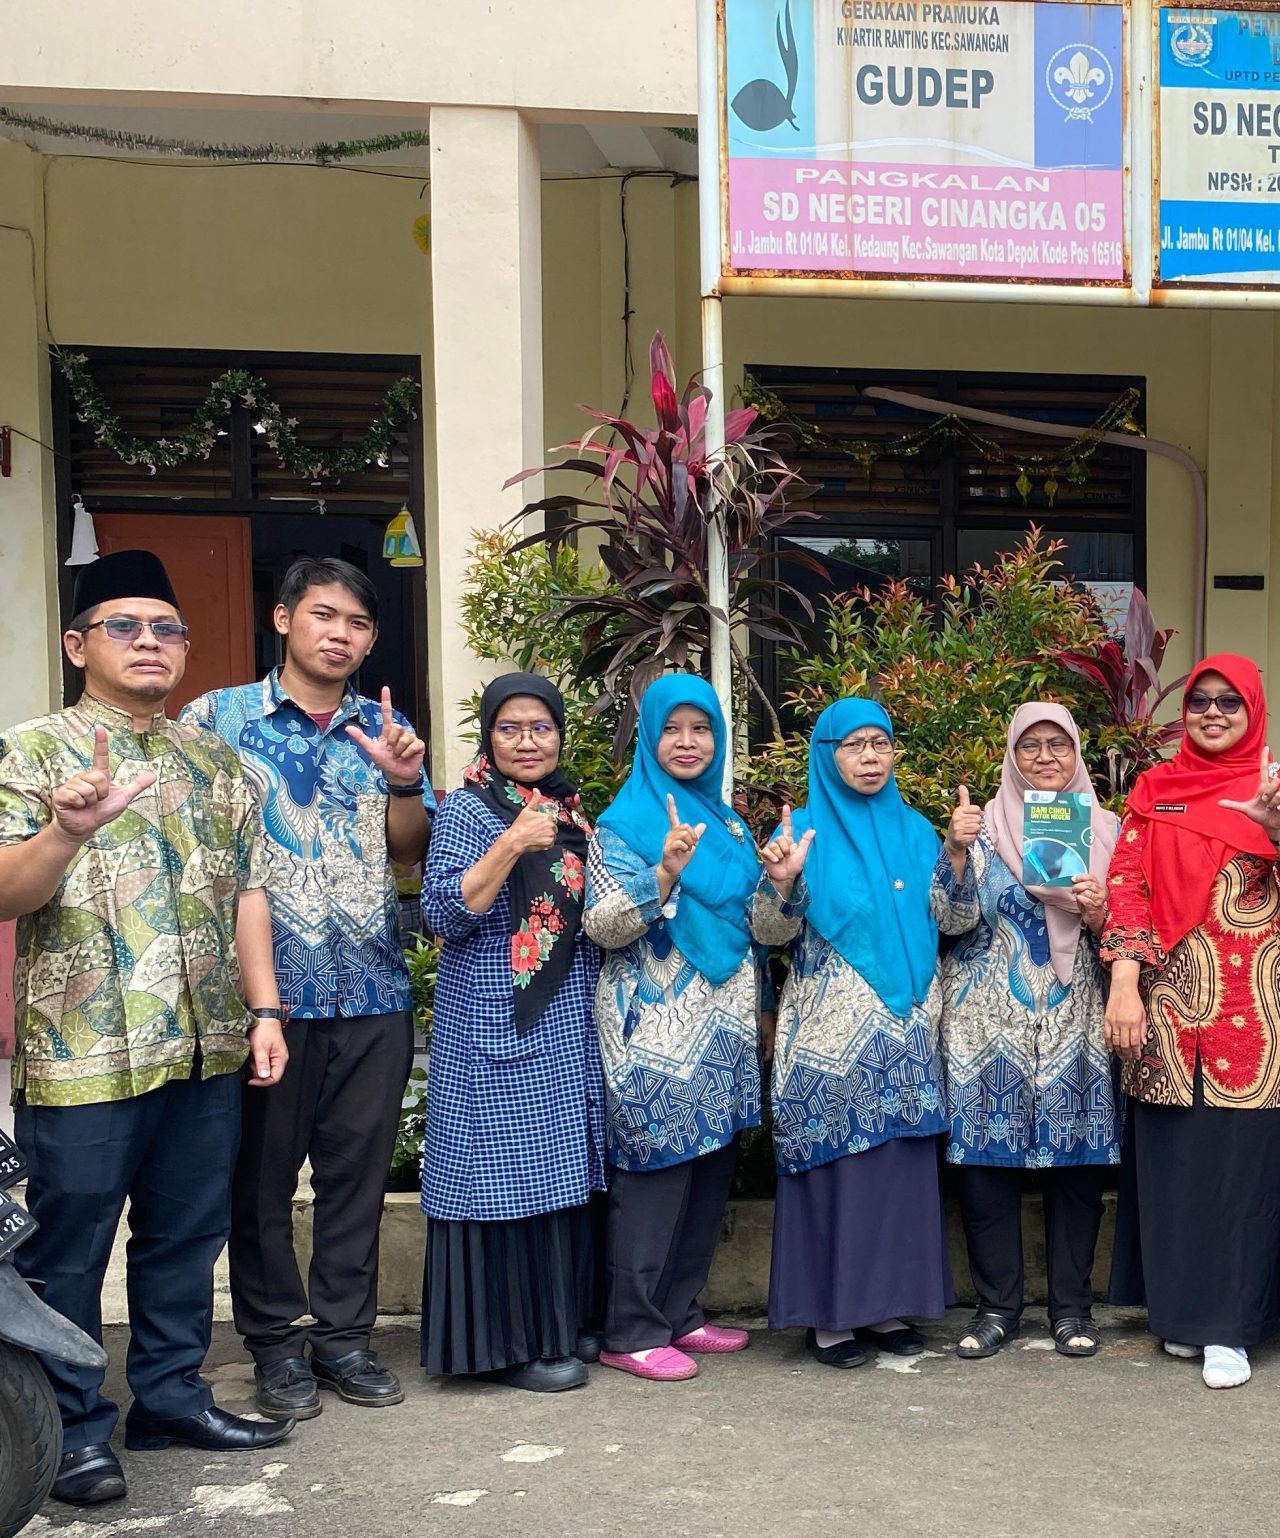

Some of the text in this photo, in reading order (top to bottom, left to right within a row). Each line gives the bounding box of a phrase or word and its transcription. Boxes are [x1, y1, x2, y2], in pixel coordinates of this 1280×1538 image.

[841, 0, 1000, 25] GERAKAN PRAMUKA
[837, 27, 882, 48] KWARTIR
[885, 29, 929, 50] RANTING
[856, 64, 994, 109] GUDEP
[1225, 70, 1260, 82] UPTD
[1193, 101, 1228, 136] SD
[795, 168, 1050, 192] PANGKALAN
[1208, 171, 1252, 192] NPSN
[763, 191, 1106, 232] SD NEGERI CINANGKA 05
[748, 230, 783, 254] Jambu
[785, 231, 797, 255] Rt
[854, 233, 899, 265] Kedaung
[980, 237, 1004, 264] Kota
[1007, 239, 1039, 269] Depok
[1042, 239, 1068, 265] Kode
[1071, 241, 1089, 265] Pos
[1092, 241, 1122, 265] 16516
[1176, 226, 1209, 250] Jambu
[1212, 227, 1223, 251] Rt
[1226, 228, 1253, 252] 01/04
[1255, 229, 1275, 253] Kel.
